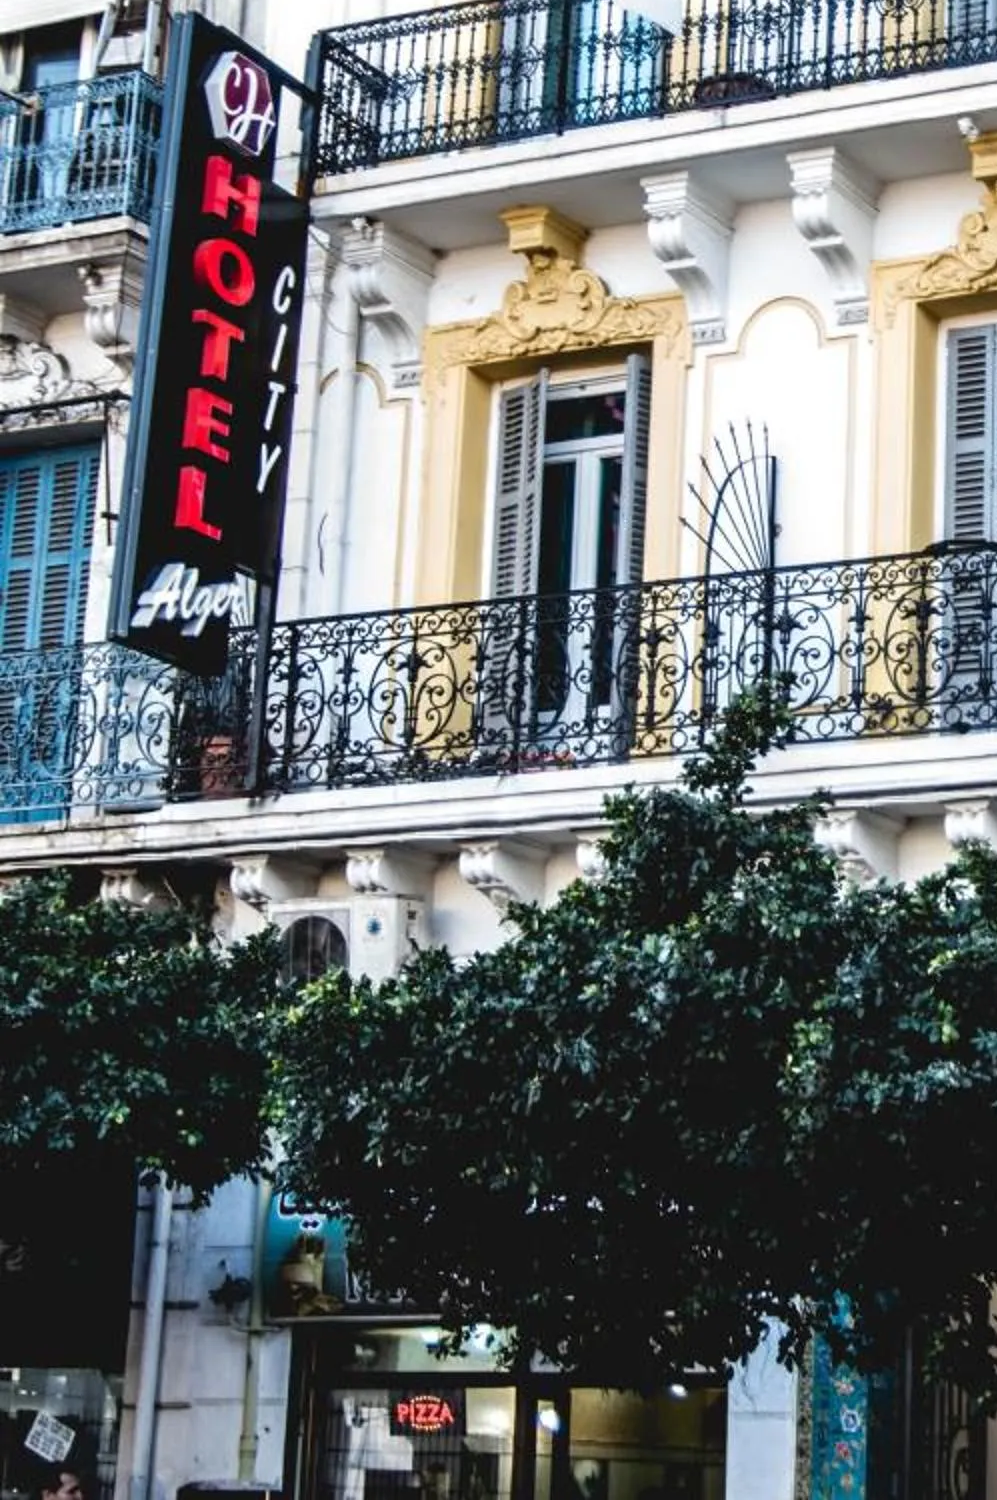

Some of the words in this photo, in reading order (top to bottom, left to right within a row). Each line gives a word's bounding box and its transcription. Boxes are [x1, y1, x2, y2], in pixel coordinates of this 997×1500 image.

[174, 154, 262, 543] HOTEL
[256, 263, 295, 495] CITY
[397, 1401, 454, 1424] PIZZA
